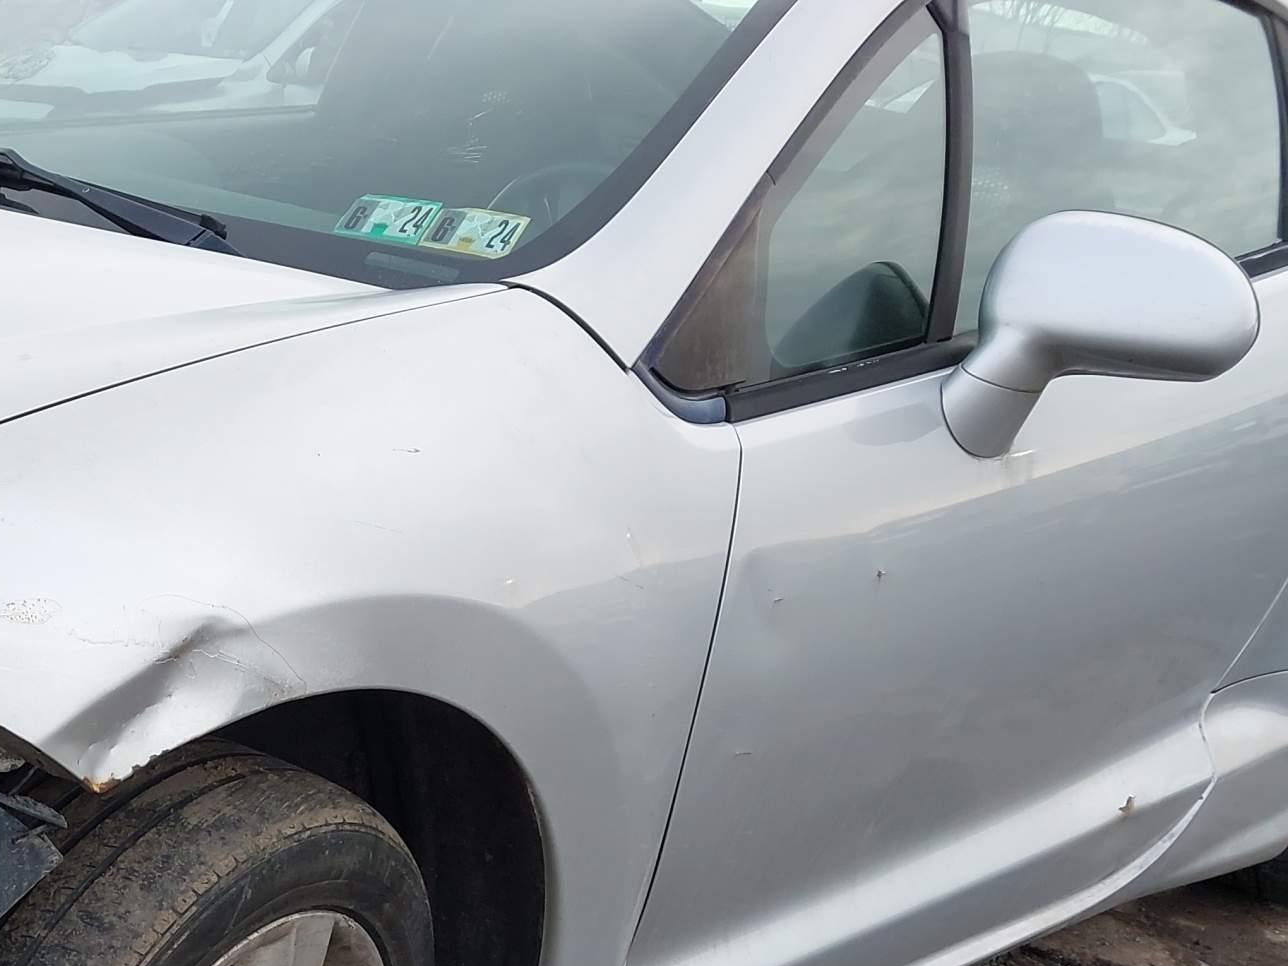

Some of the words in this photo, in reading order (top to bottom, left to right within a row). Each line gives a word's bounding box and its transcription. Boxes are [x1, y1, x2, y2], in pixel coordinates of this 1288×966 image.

[345, 206, 368, 230] 6
[398, 206, 431, 236] 24
[431, 216, 456, 242] 6
[485, 219, 521, 252] 24
